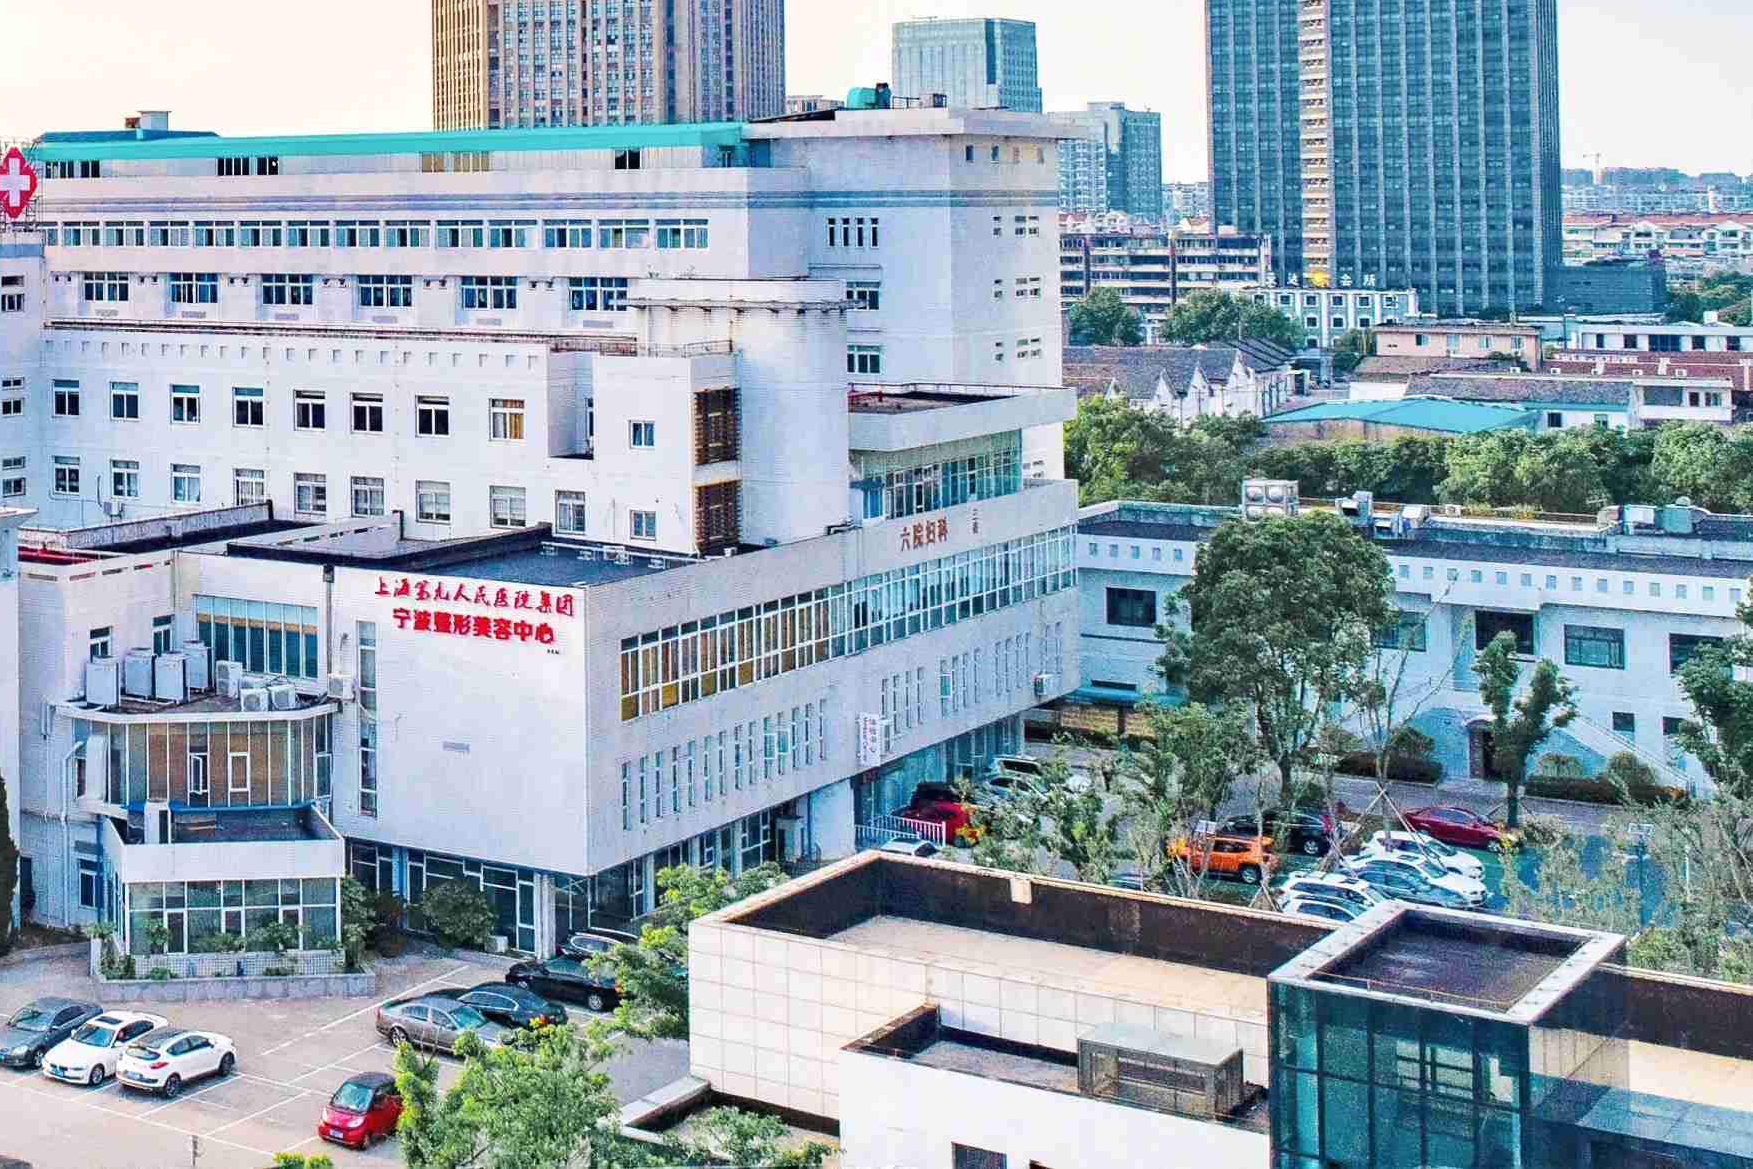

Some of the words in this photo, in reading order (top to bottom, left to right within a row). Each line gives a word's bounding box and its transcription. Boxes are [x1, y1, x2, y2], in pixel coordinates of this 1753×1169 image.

[374, 575, 576, 618] 上海第九人民医院集团
[392, 607, 557, 645] 宁波整形美容中心
